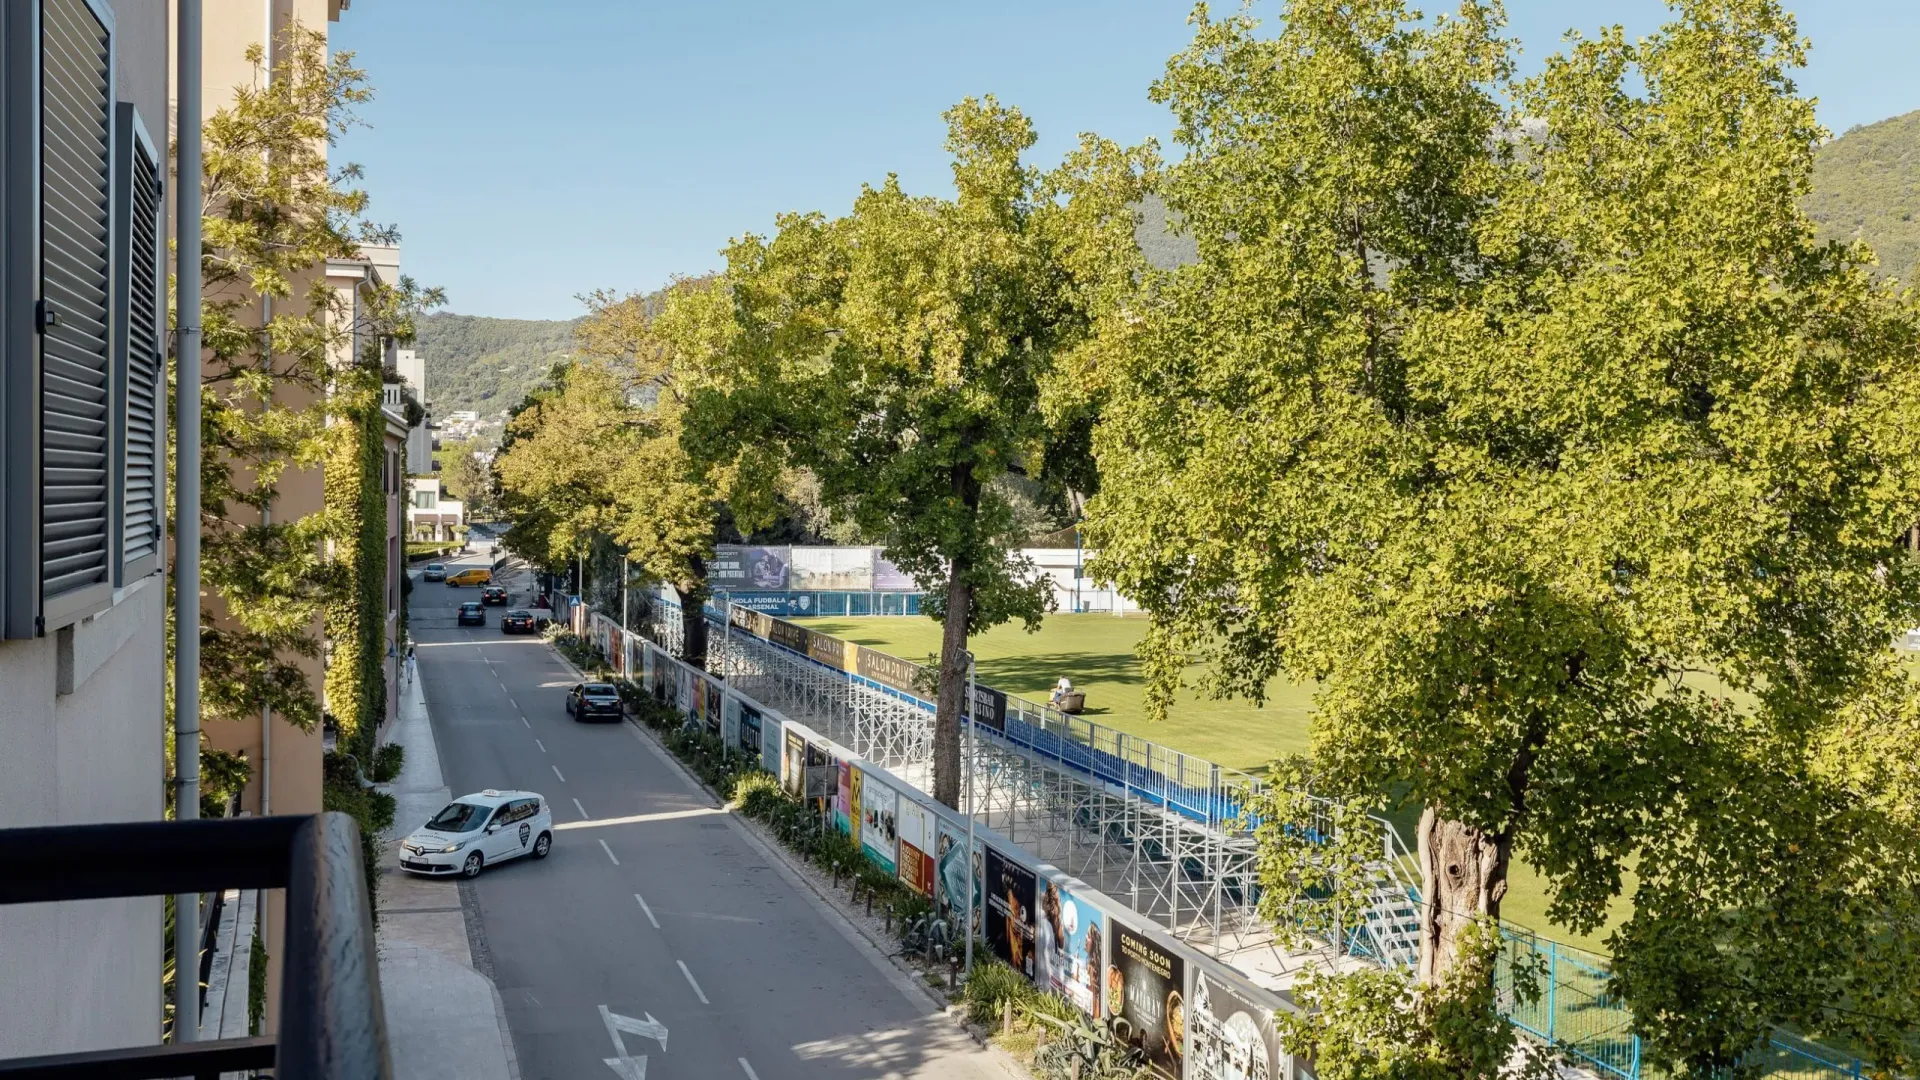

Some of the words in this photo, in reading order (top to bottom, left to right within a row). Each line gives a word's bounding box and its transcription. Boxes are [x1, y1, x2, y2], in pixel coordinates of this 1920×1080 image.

[754, 596, 786, 604] FUDBALA
[812, 636, 831, 652] SALON
[867, 654, 890, 674] SALON
[892, 662, 914, 682] PRIVÉ
[964, 685, 995, 708] SRTSBAR
[971, 701, 995, 720] ASINO
[1121, 934, 1148, 956] COMING
[1149, 950, 1172, 970] SOON
[1141, 956, 1172, 980] MONTENEGRO
